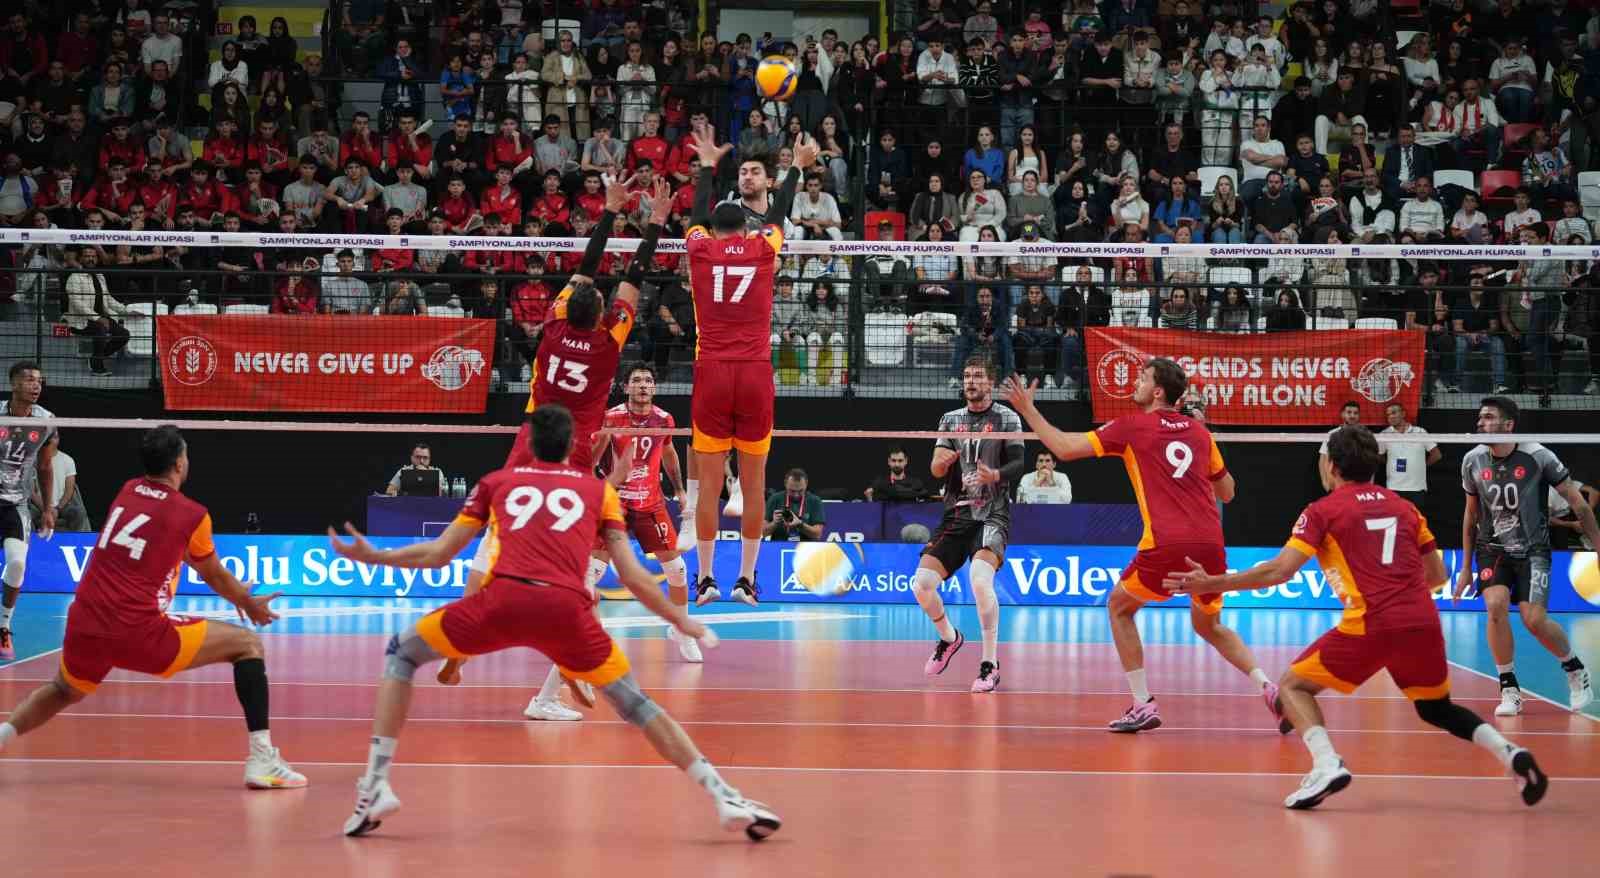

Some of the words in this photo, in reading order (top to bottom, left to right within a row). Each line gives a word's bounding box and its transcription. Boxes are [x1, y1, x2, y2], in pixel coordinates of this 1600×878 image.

[153, 235, 195, 244] KUPASI
[343, 237, 385, 247] KUPASI
[533, 240, 575, 249] KUPASI
[913, 244, 955, 253] KUPASI
[1103, 246, 1146, 254] KUPASI
[1294, 247, 1337, 256] KUPASI
[1485, 248, 1527, 257] KUPASI
[711, 264, 757, 303] 17
[561, 336, 591, 351] MAAR
[234, 351, 309, 374] NEVER
[318, 352, 374, 374] GIVE
[383, 352, 415, 374] UP
[545, 353, 590, 393] 13
[1166, 355, 1264, 379] GENDS
[1271, 356, 1351, 379] NEVER
[1243, 384, 1327, 406] ALONE
[5, 440, 25, 461] 14
[631, 436, 652, 460] 19
[1165, 441, 1193, 478] 9
[1487, 482, 1519, 510] 20
[505, 485, 585, 532] 99
[98, 507, 151, 560] 14
[655, 522, 669, 537] 19
[1365, 516, 1398, 565] 7
